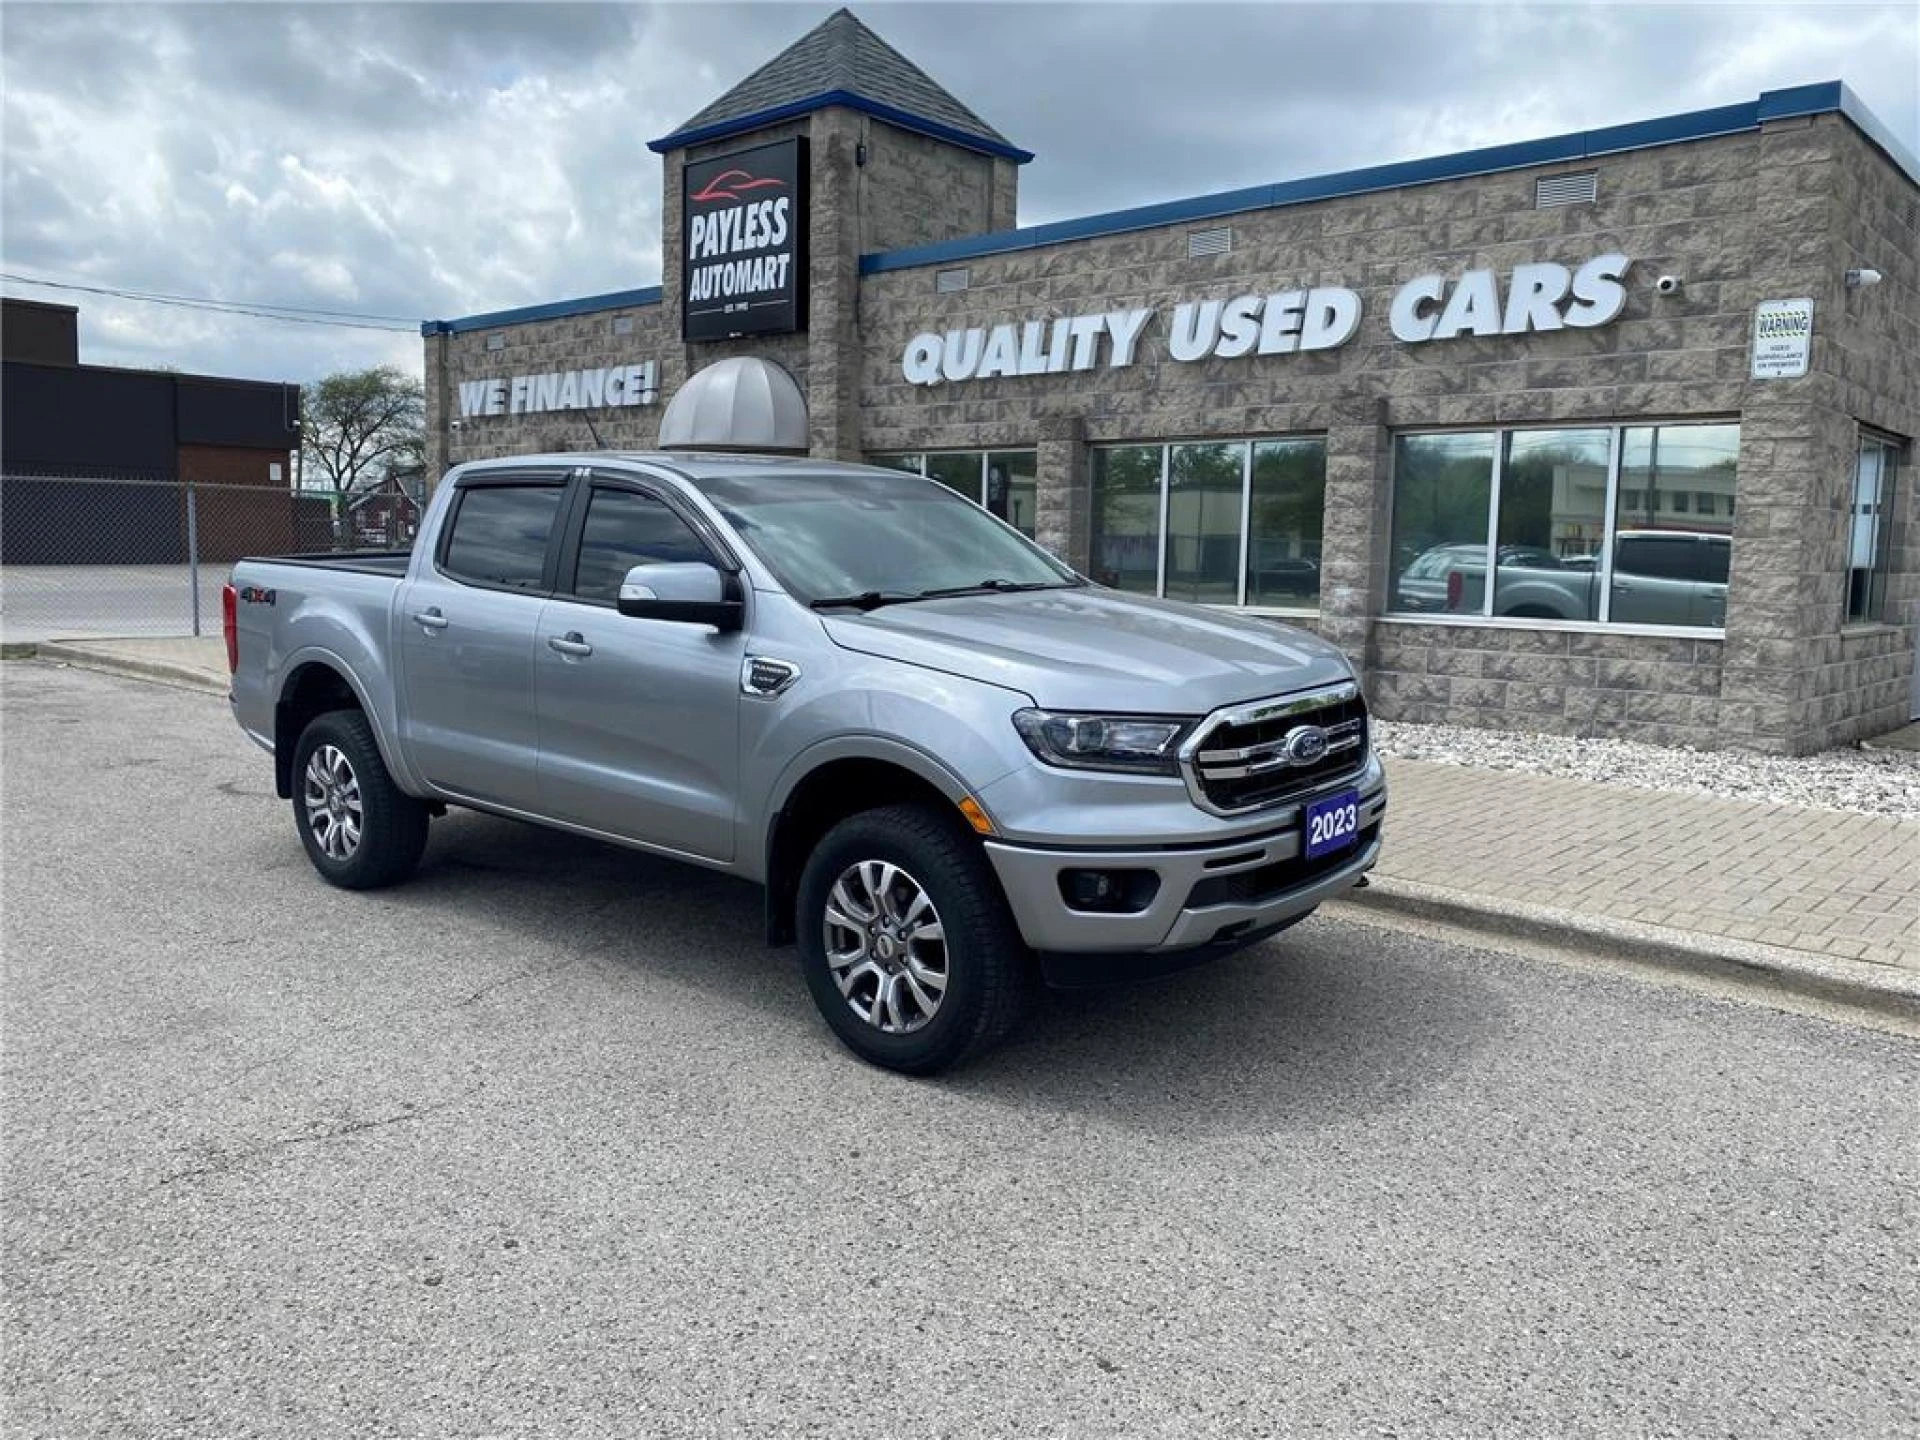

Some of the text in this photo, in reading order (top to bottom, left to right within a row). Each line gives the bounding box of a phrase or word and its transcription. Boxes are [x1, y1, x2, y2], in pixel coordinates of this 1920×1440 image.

[689, 196, 790, 260] PAYLESS
[689, 253, 790, 302] AUTOMART
[902, 251, 1632, 387] QUALITY USED CARS
[1759, 317, 1808, 333] WARNING
[458, 359, 661, 417] WE FINANCE!
[1310, 803, 1357, 845] 2023
